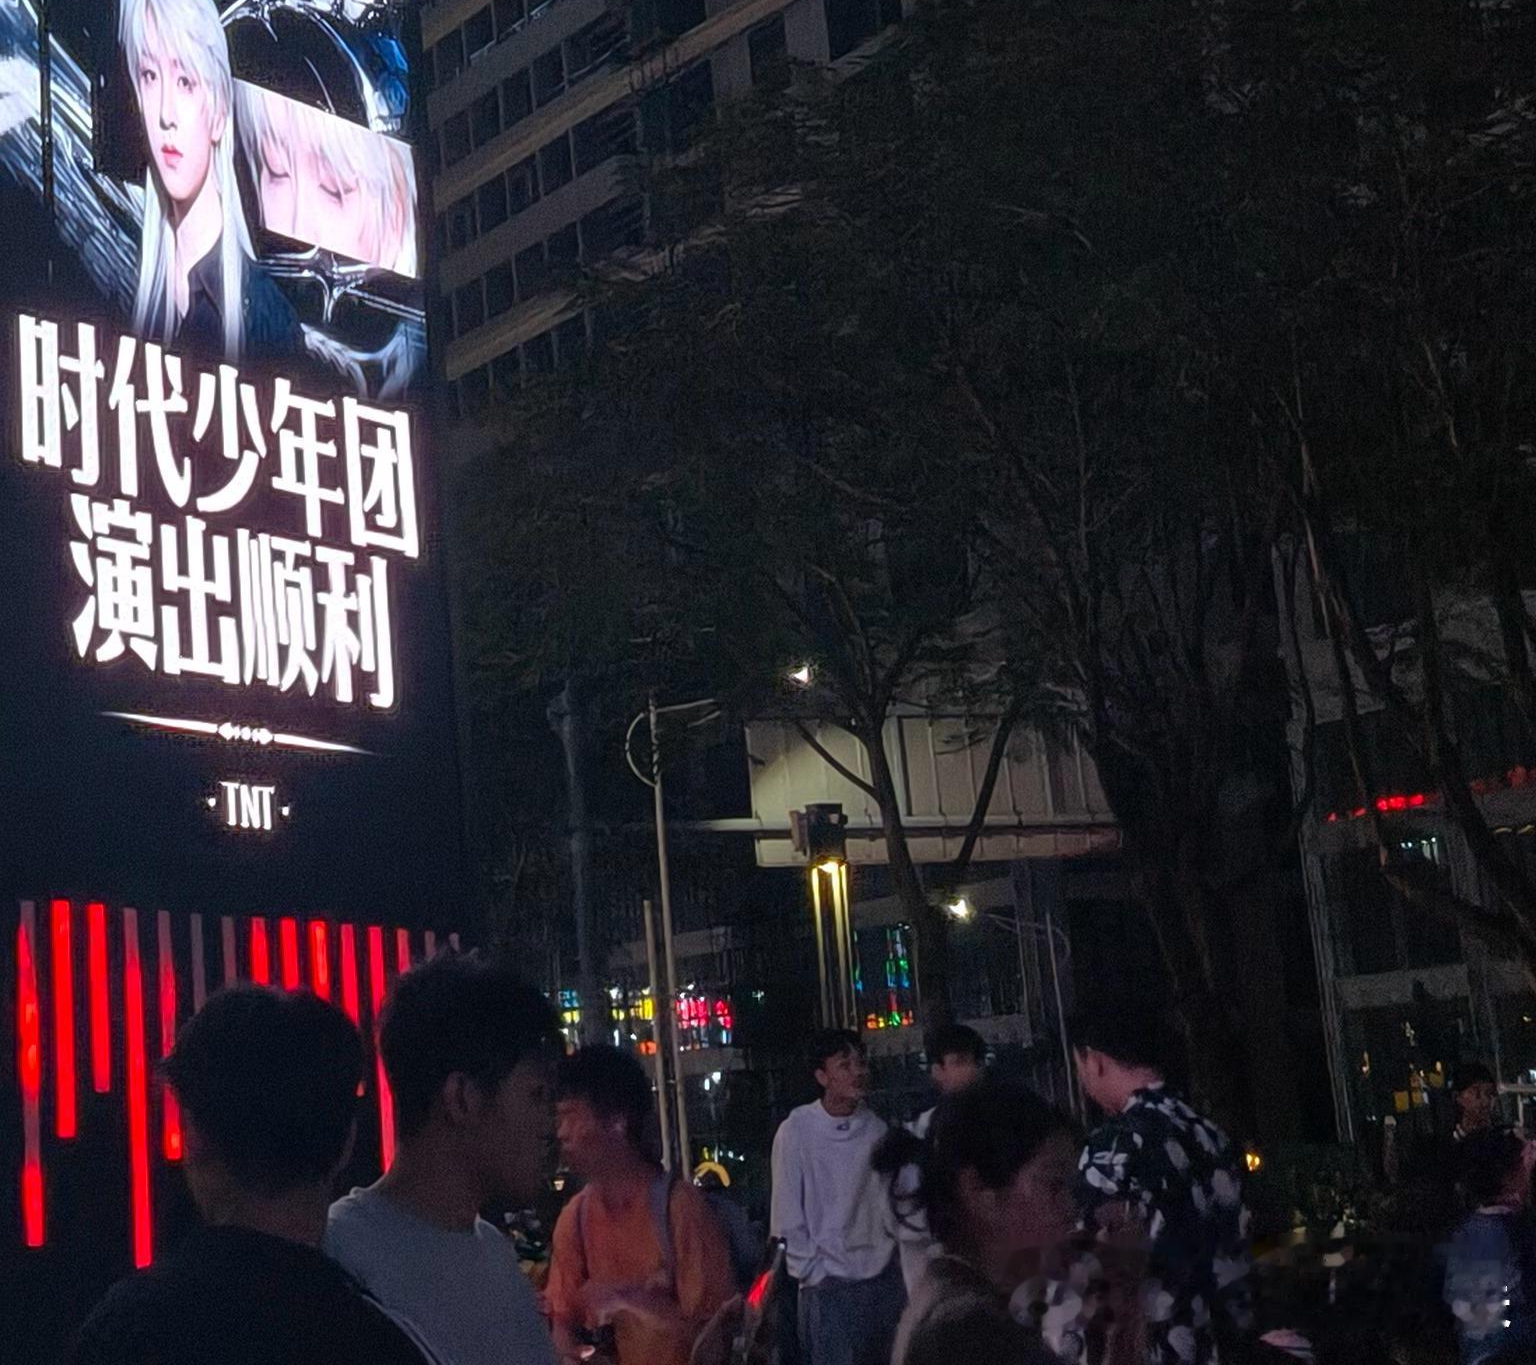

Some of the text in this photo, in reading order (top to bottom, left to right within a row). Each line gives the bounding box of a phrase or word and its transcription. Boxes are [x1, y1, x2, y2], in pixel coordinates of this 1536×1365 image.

[19, 314, 420, 558] 时代少年团
[69, 493, 396, 709] 演出顺利
[219, 781, 275, 830] TNT
